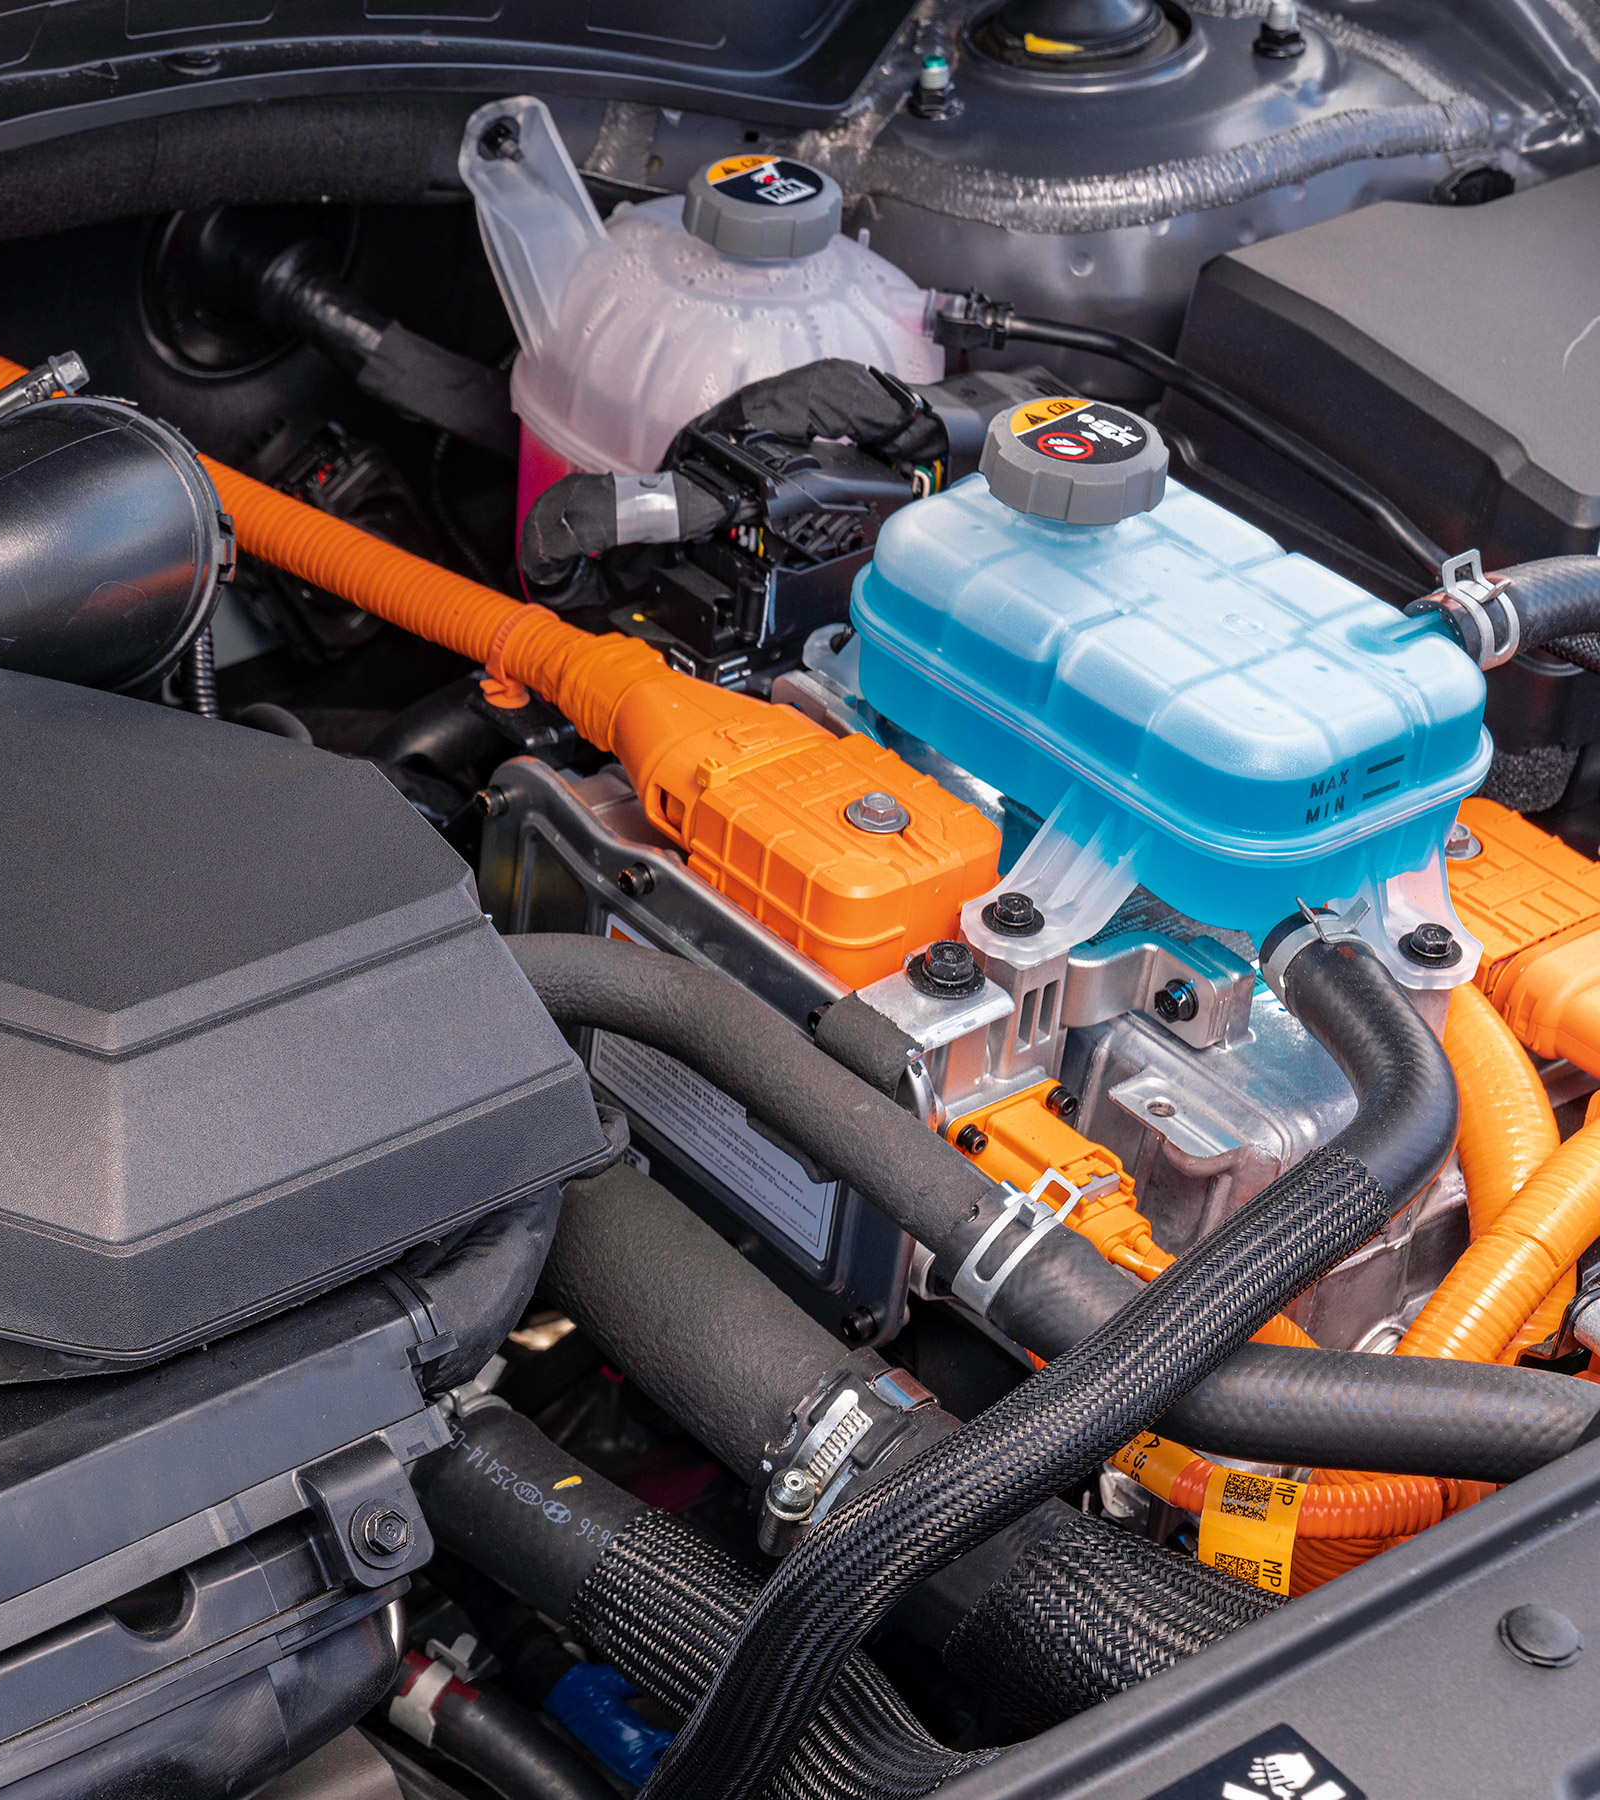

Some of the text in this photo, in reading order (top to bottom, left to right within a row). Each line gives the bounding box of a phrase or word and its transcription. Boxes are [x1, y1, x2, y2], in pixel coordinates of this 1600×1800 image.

[1310, 769, 1349, 799] MAX
[1305, 795, 1345, 825] MIN
[517, 1483, 540, 1503] KIA
[1275, 1482, 1298, 1506] MP
[1263, 1559, 1283, 1588] MP
